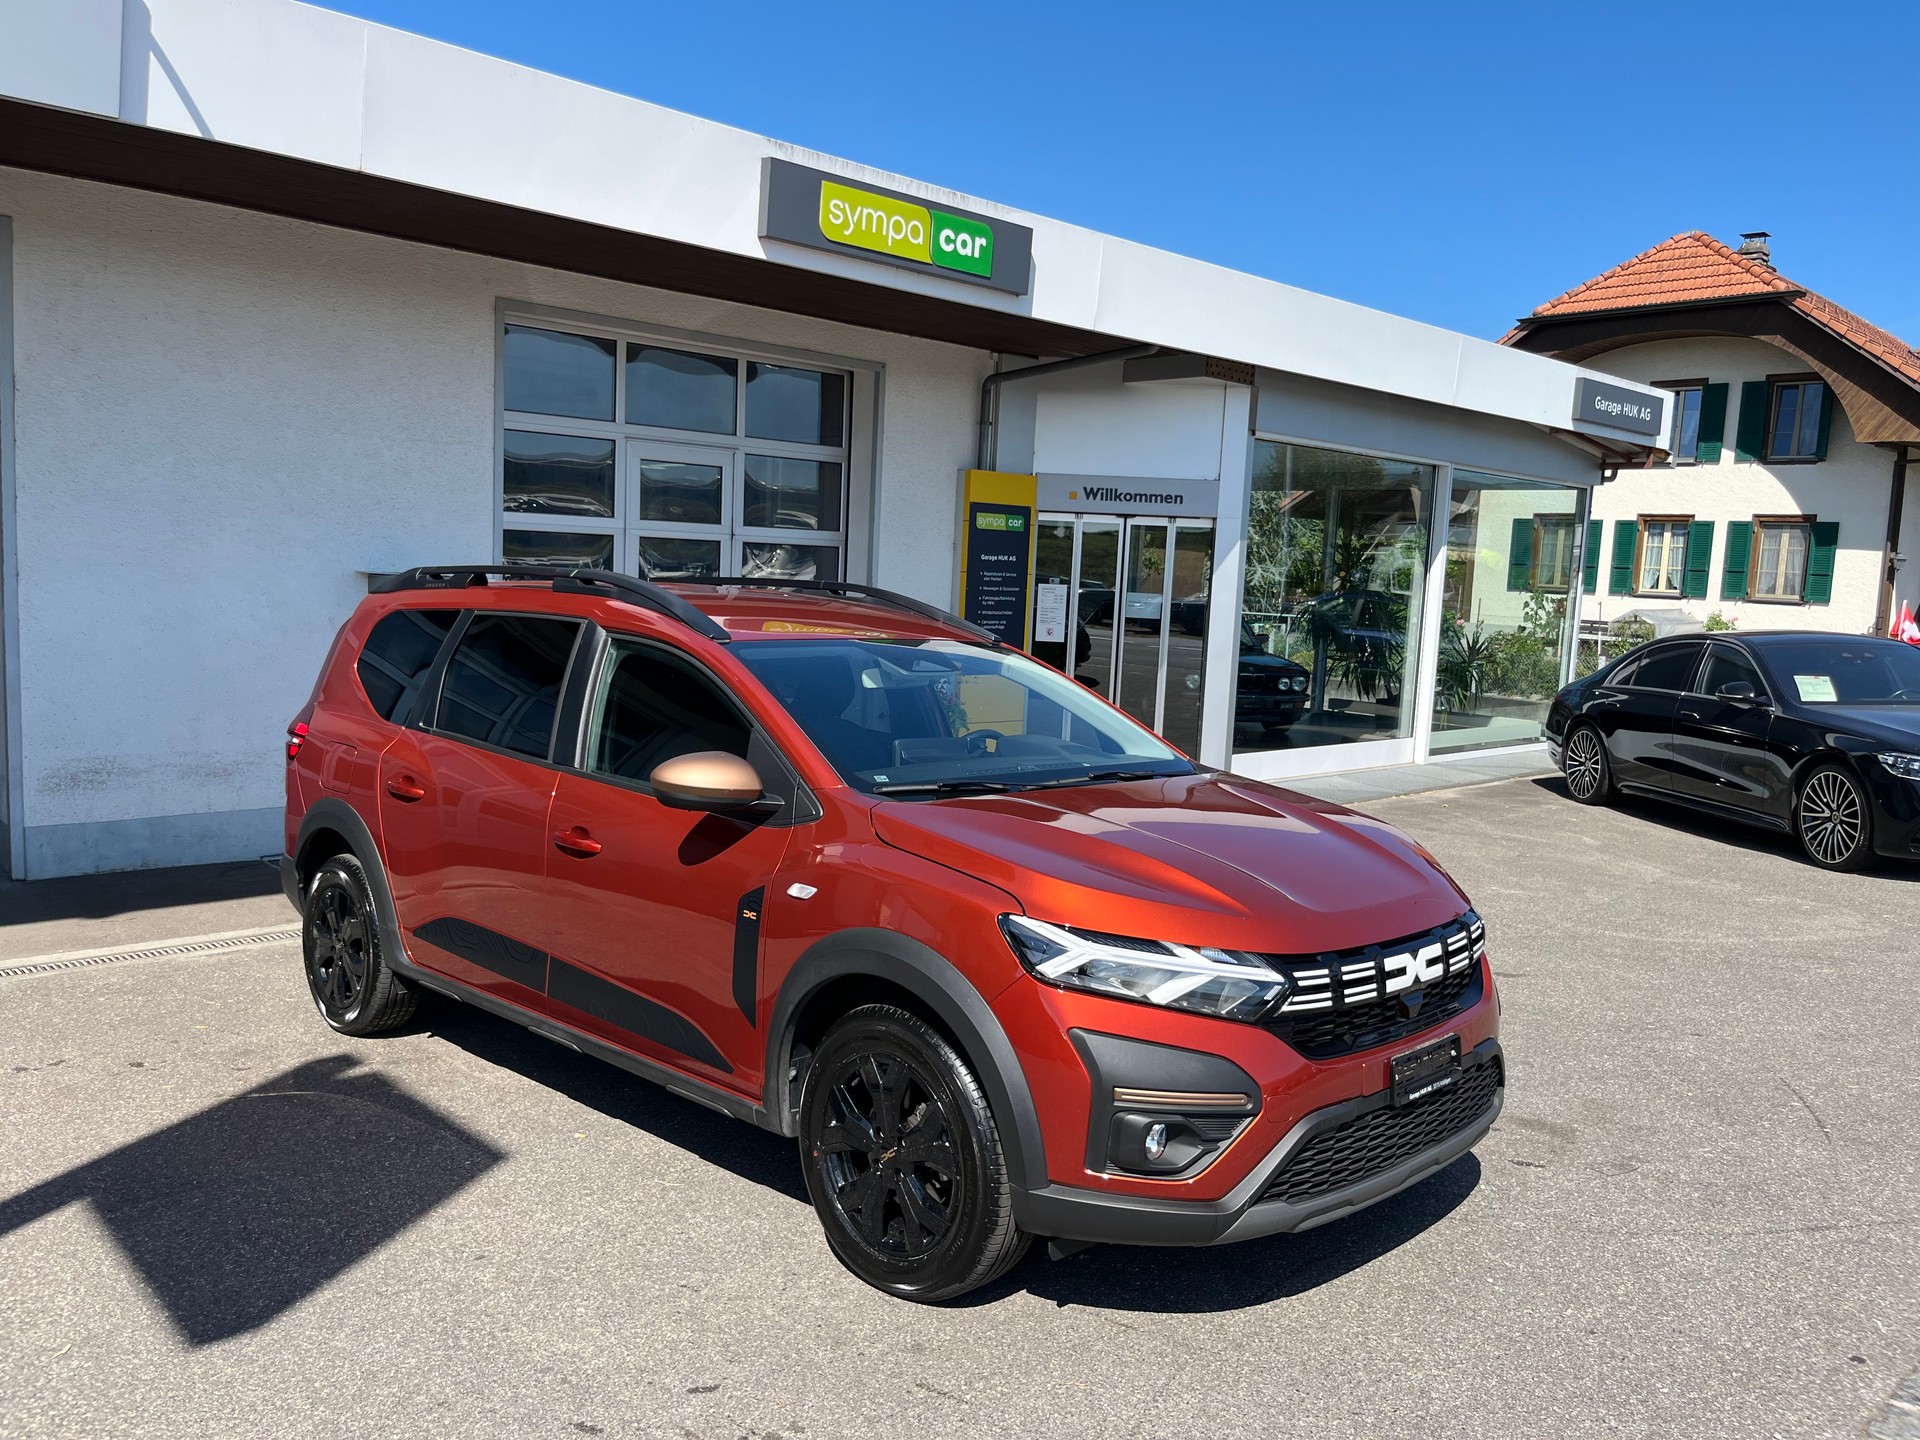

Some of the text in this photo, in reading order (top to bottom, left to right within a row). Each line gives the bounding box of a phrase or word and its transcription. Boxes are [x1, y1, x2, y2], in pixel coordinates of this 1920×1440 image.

[829, 200, 987, 259] sympa car
[1595, 396, 1651, 421] Garage HUK AG
[1083, 486, 1184, 505] Willkommen
[978, 516, 1022, 527] sympa car
